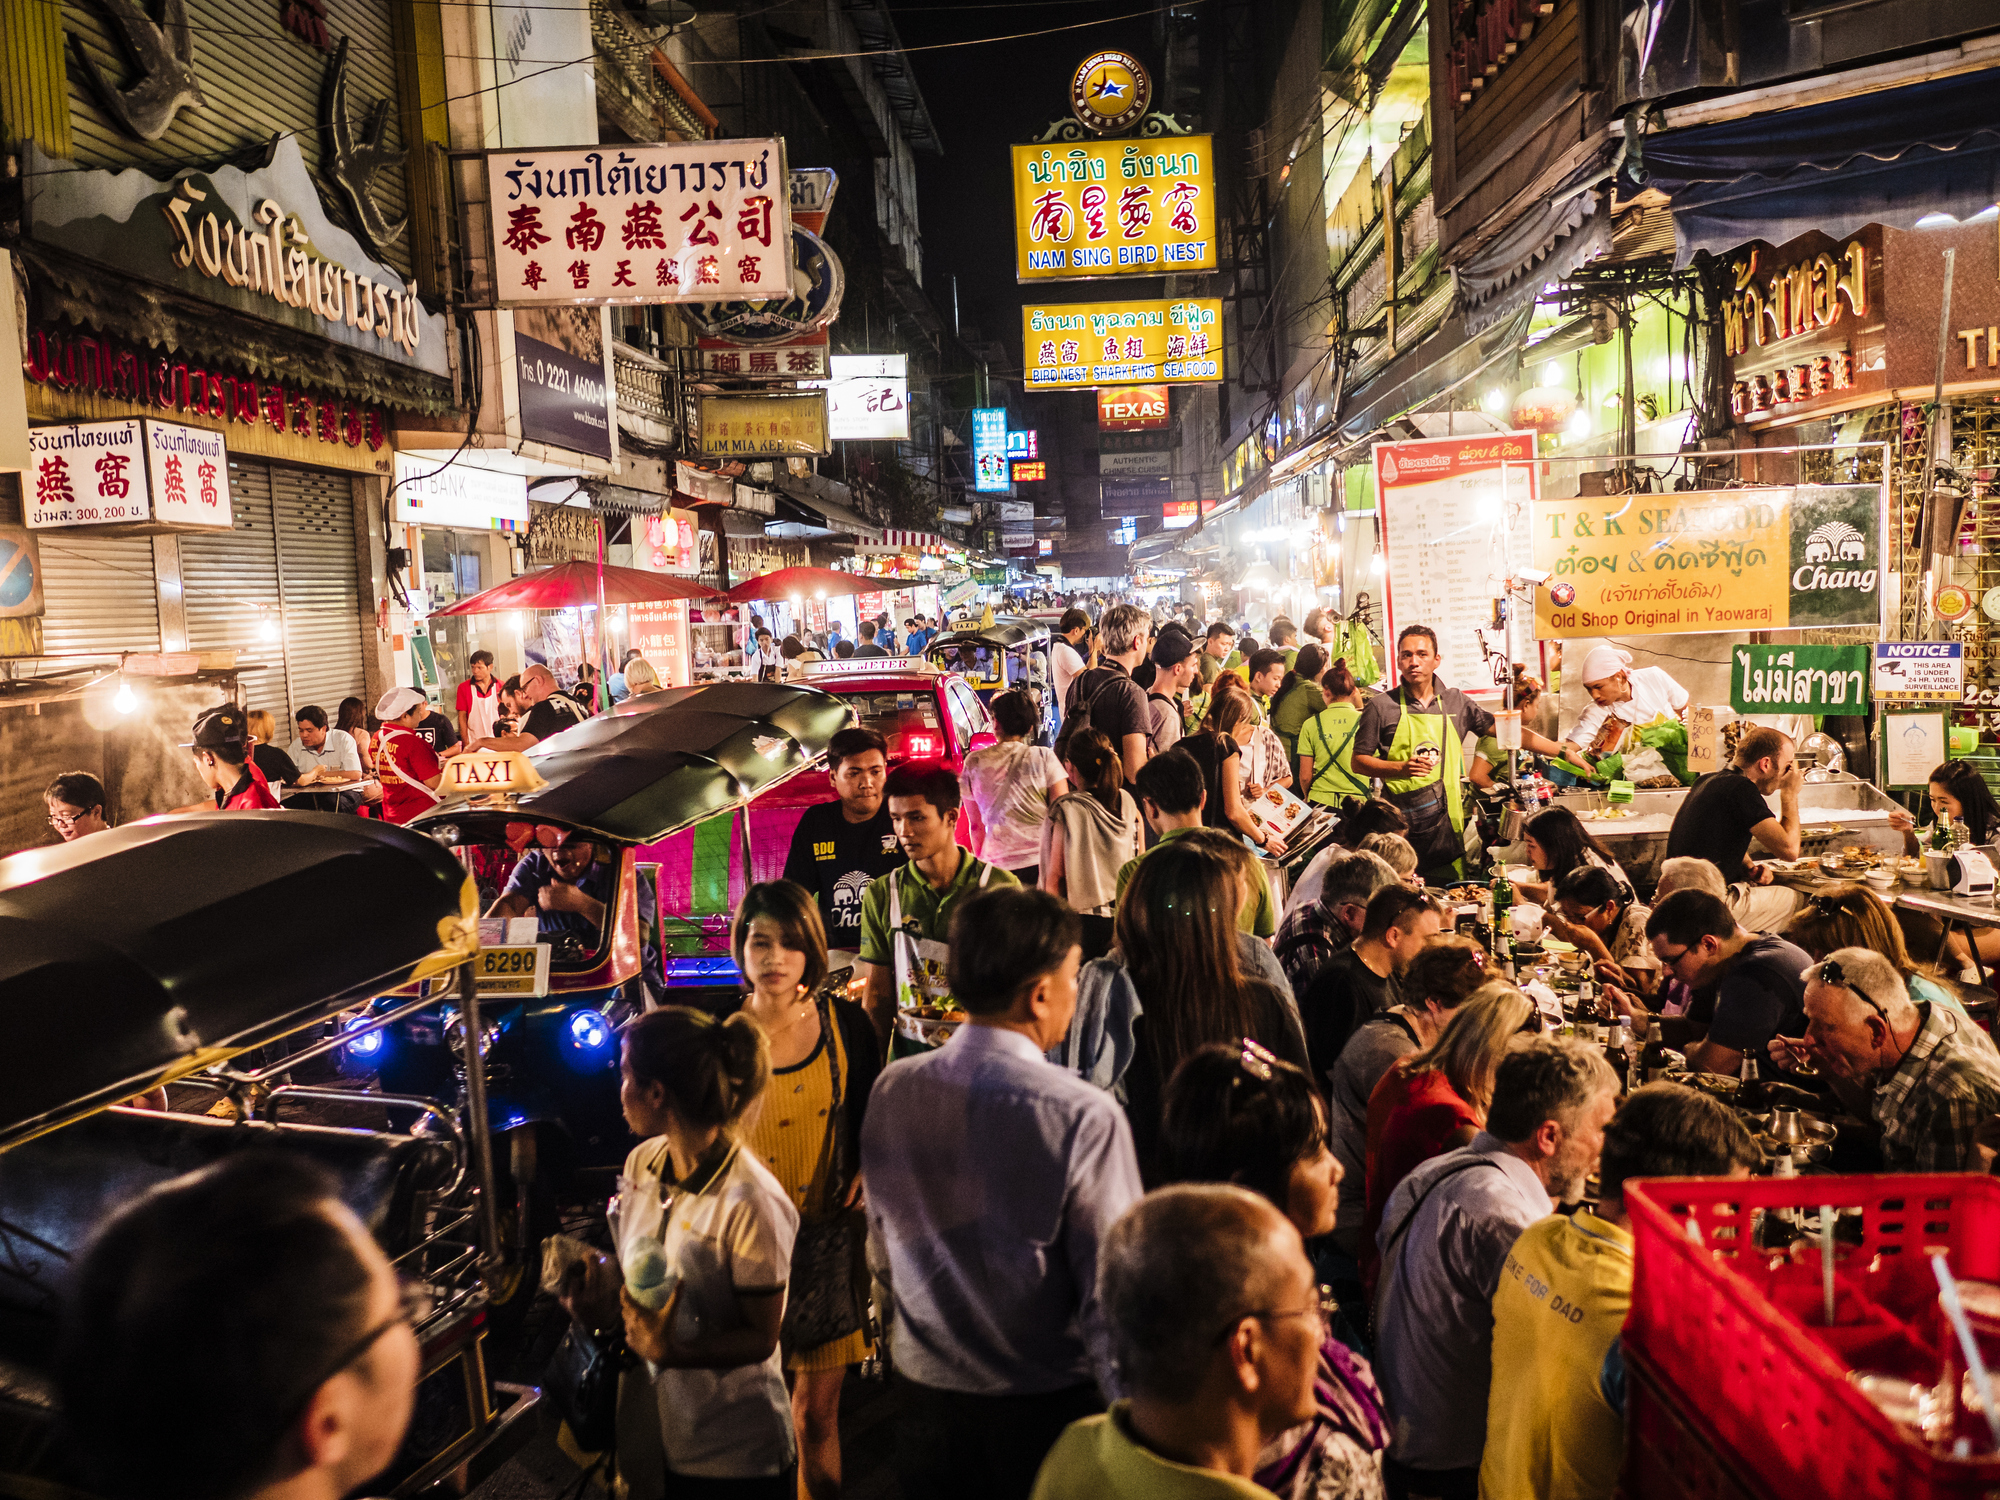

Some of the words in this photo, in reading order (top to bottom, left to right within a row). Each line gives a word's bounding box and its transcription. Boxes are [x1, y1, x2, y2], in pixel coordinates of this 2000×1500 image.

[1075, 66, 1089, 87] NAM
[1120, 146, 1200, 179] รังนก
[505, 149, 770, 200] รังนกใต้เยาวราช
[502, 194, 774, 256] 泰南燕公司
[1028, 250, 1066, 269] NAM
[1071, 247, 1112, 267] SING
[1118, 244, 1158, 265] BIRD
[1163, 242, 1206, 262] NEST
[720, 317, 740, 330] LION
[770, 314, 797, 329] HORSE
[1030, 310, 1086, 332] รังนก
[1032, 369, 1060, 383] BIRD
[1060, 367, 1088, 382] NEST
[1093, 365, 1130, 381] SHARK
[1131, 363, 1156, 379] FINS
[1163, 362, 1185, 378] SEA
[1185, 361, 1216, 377] FOOD
[537, 359, 544, 385] 0
[547, 363, 570, 394] 2221
[573, 374, 605, 408] 4600-2
[1101, 401, 1166, 419] TEXAS
[29, 422, 136, 452] รังนกไทยแท้
[153, 426, 221, 458] รังนกไทยแท้
[706, 440, 729, 452] LIM
[732, 440, 756, 452] MIA
[760, 440, 785, 452] KEE
[1112, 455, 1157, 465] AUTHENTIC
[1489, 447, 1499, 457] &
[1501, 442, 1523, 457] คิด
[36, 451, 131, 506] 燕窩
[164, 453, 218, 508] 燕窩
[1103, 466, 1138, 475] CHINESE
[1137, 465, 1168, 474] CUISINE
[1483, 475, 1525, 487] Seaood
[430, 470, 467, 499] BANK
[104, 506, 126, 519] 200
[1546, 512, 1566, 539] T
[1574, 511, 1595, 537] &
[1602, 510, 1626, 536] K
[1555, 545, 1618, 576] ต๋อย
[1628, 550, 1648, 573] &
[1792, 564, 1878, 593] Chang
[955, 622, 974, 630] TAXI
[1551, 610, 1576, 629] Old
[1581, 610, 1619, 630] Shop
[1624, 608, 1681, 628] Original
[1686, 608, 1699, 622] in
[1705, 603, 1773, 623] Yaowaraj
[1887, 645, 1950, 657] NOTICE
[817, 662, 851, 673] TAXI
[857, 659, 908, 671] METER
[1735, 649, 1863, 705] ไม่มีสาขา
[1692, 711, 1713, 724] 250
[1692, 724, 1714, 736] 500
[451, 760, 513, 784] TAXI
[813, 841, 836, 856] BDU
[830, 906, 862, 928] Cha
[484, 951, 535, 973] 6290
[928, 974, 949, 988] Foo
[1524, 1273, 1549, 1300] FOR
[1550, 1295, 1585, 1325] DAD
